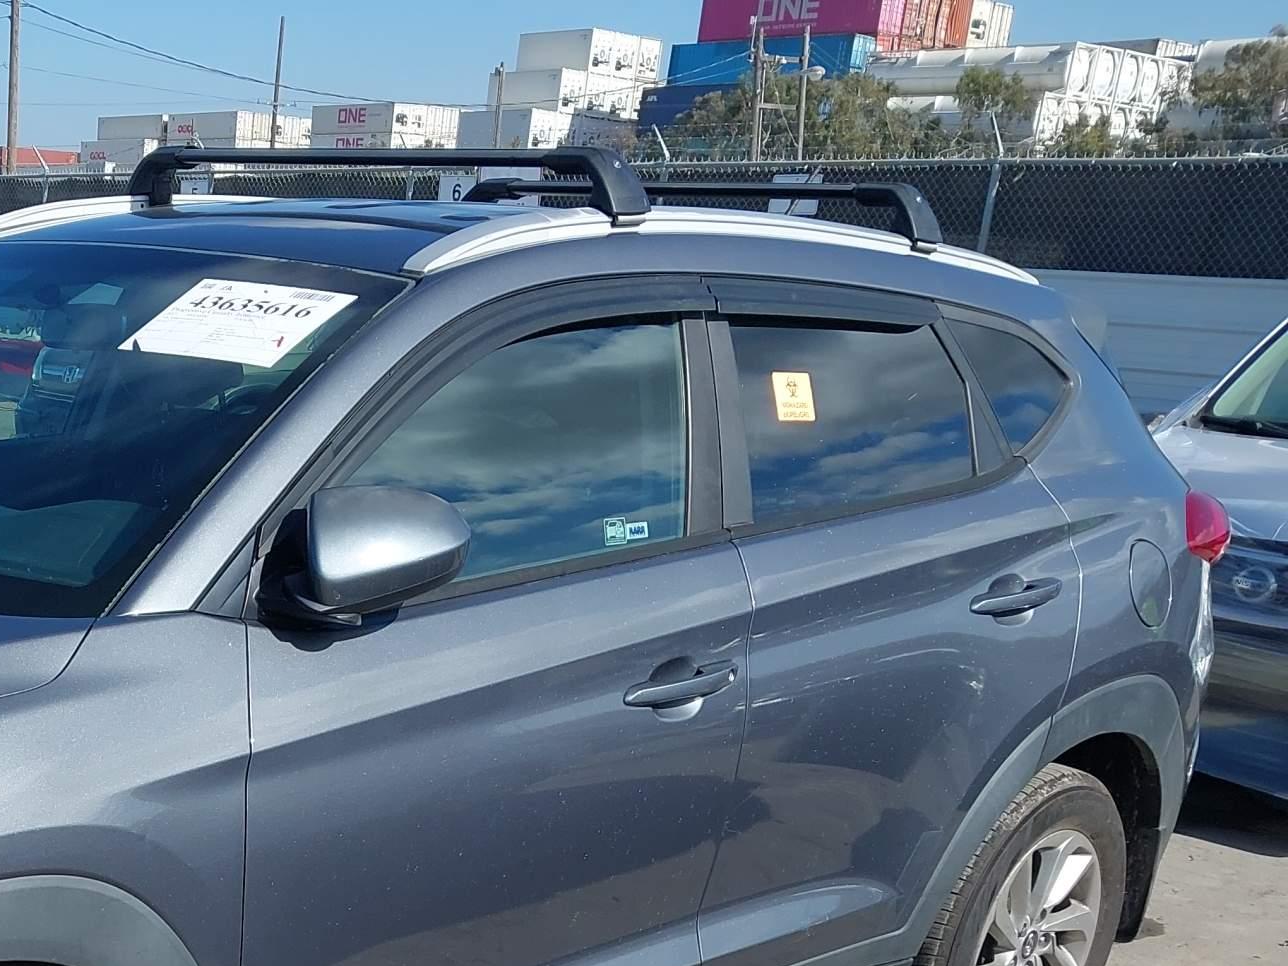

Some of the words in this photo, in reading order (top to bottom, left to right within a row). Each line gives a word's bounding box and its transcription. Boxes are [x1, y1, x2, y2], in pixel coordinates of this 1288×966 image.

[757, 0, 819, 22] ONE
[338, 108, 366, 124] ONE
[452, 183, 462, 201] 6
[190, 295, 318, 318] 43635616
